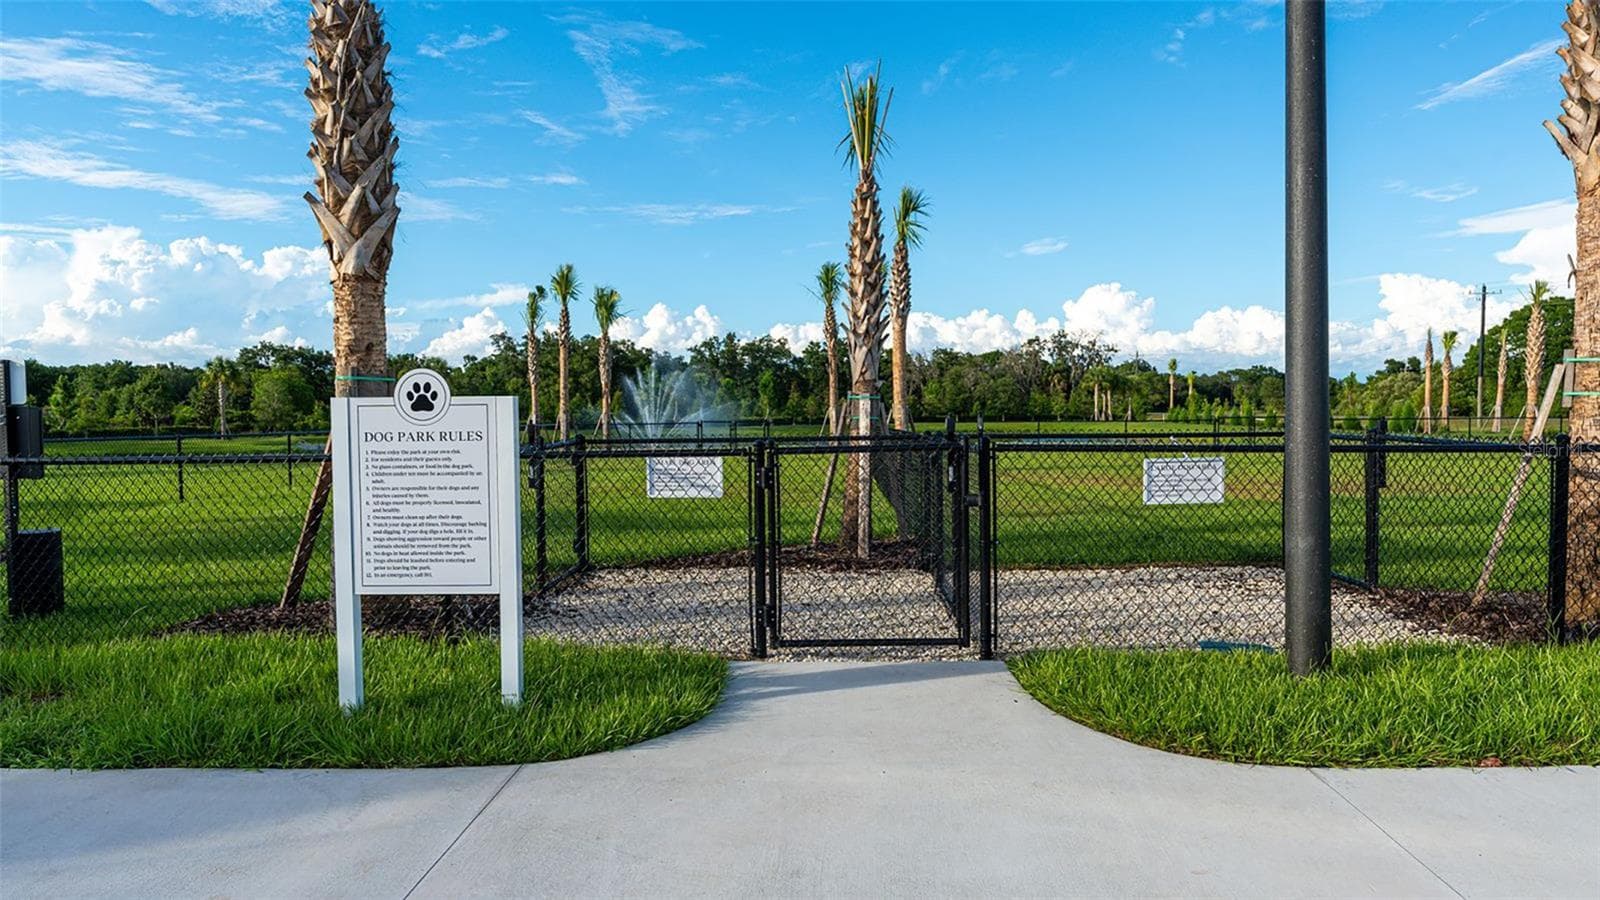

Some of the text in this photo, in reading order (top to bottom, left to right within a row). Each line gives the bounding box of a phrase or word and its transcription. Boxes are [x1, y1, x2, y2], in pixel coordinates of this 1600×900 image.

[365, 431, 483, 442] DOG PARK RULES
